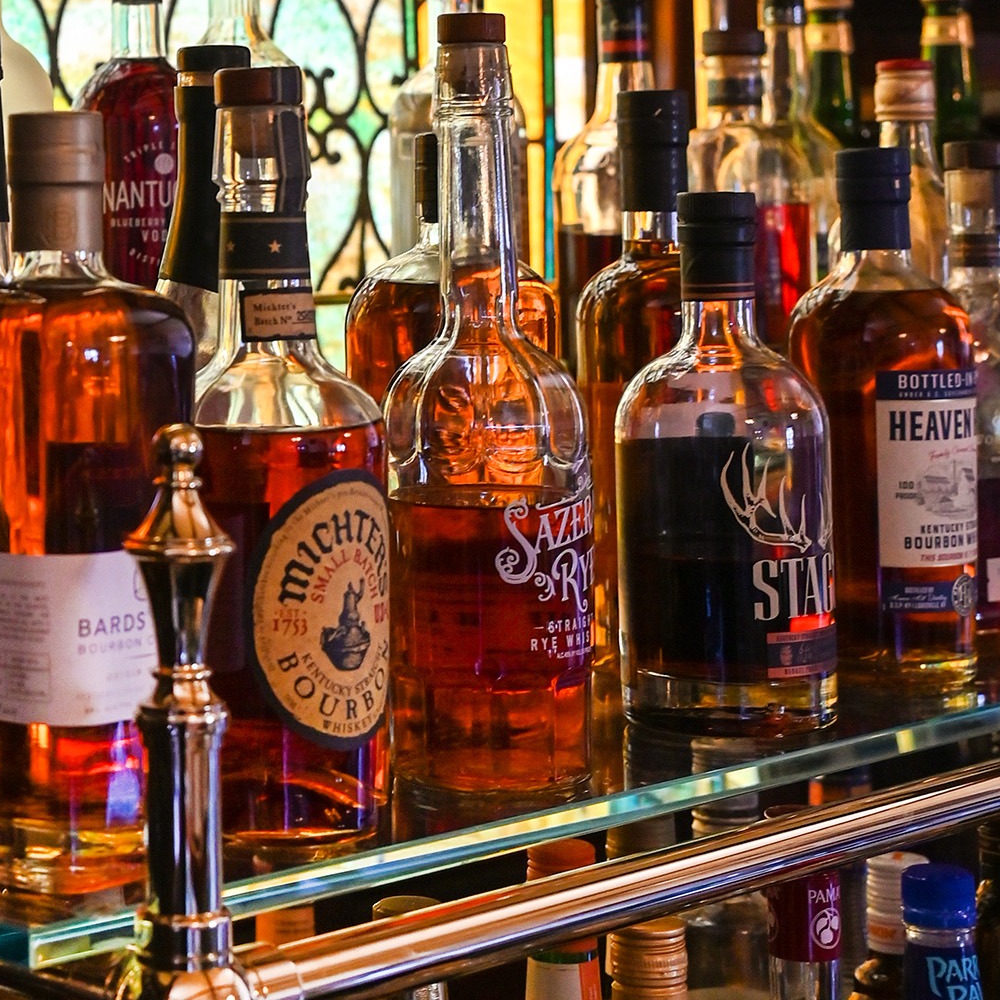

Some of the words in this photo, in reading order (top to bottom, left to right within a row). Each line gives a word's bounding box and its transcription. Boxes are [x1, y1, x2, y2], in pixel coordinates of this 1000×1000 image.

[110, 218, 166, 228] BLUEBERRY
[889, 408, 971, 441] HEAVEN
[899, 481, 914, 489] 100
[921, 523, 964, 534] KENTUCKY
[904, 535, 964, 550] BOURBON
[311, 549, 350, 604] SMALL
[354, 548, 378, 599] BATCH
[78, 611, 146, 637] BARDS
[273, 618, 307, 636] 1753
[531, 636, 558, 651] RYE
[278, 639, 389, 719] BOURBON
[301, 652, 352, 697] KENTUCKY
[323, 716, 373, 733] WHISKEY
